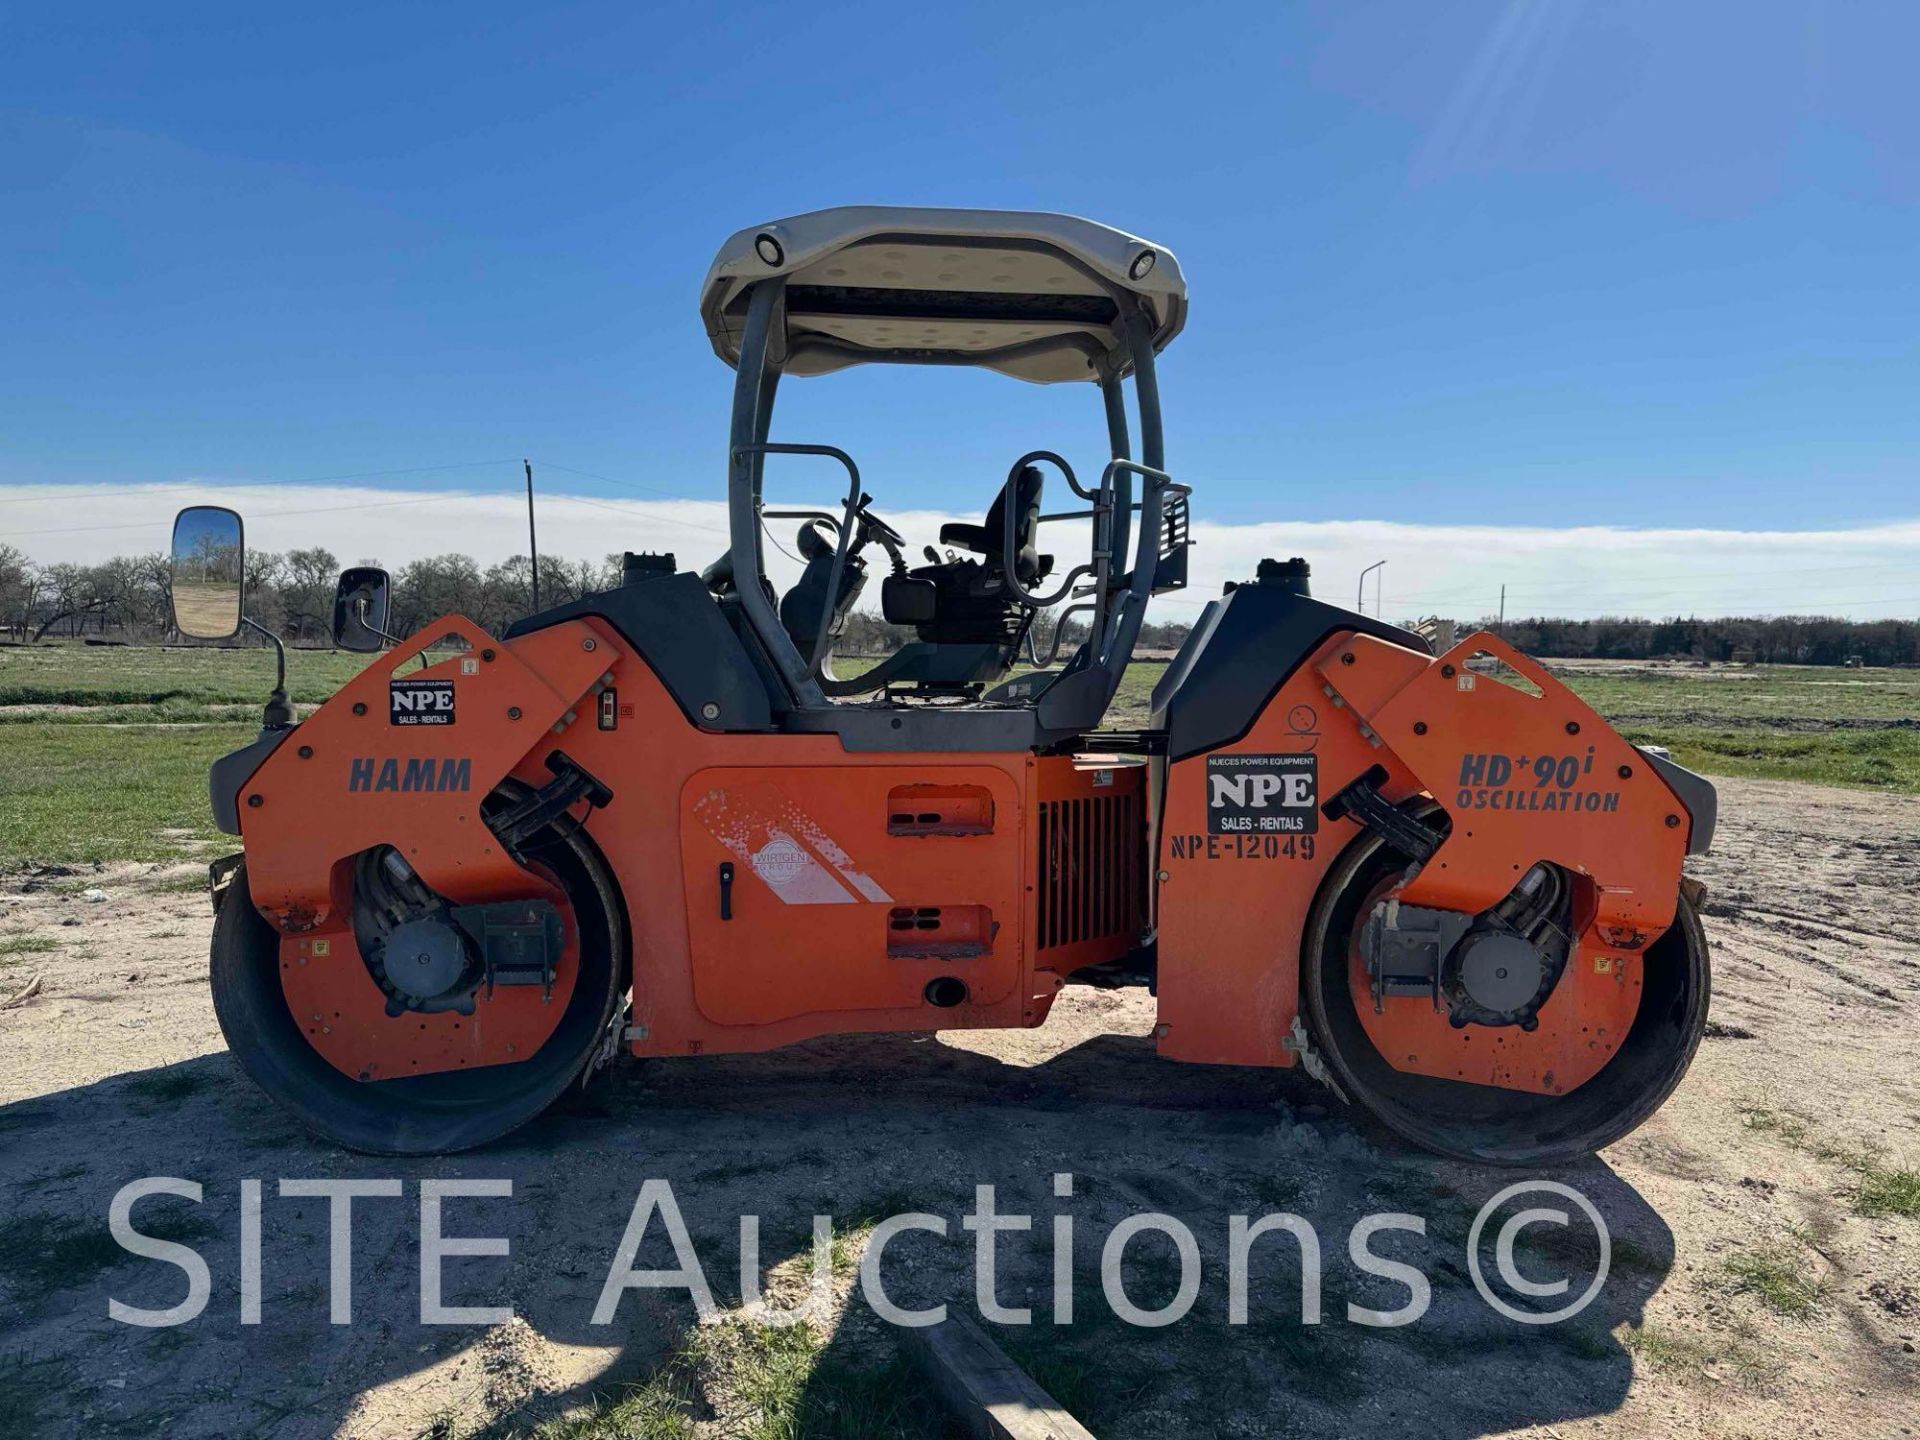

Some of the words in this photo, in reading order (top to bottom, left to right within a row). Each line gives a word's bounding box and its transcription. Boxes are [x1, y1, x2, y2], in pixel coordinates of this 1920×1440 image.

[391, 690, 454, 711] NPE
[399, 716, 418, 724] SALES
[422, 716, 447, 724] RENTALS
[1209, 757, 1240, 766] NUECES
[1241, 757, 1269, 766] POWER
[1270, 757, 1314, 765] EQUIPMENT
[348, 758, 472, 792] HAMM
[1208, 773, 1315, 808] NPE
[1455, 788, 1621, 812] OSCILLATION
[1221, 817, 1252, 830] SALES
[1259, 816, 1304, 830] RENTALS
[756, 853, 806, 862] WIRTGEN
[1171, 835, 1315, 860] NPE-12049
